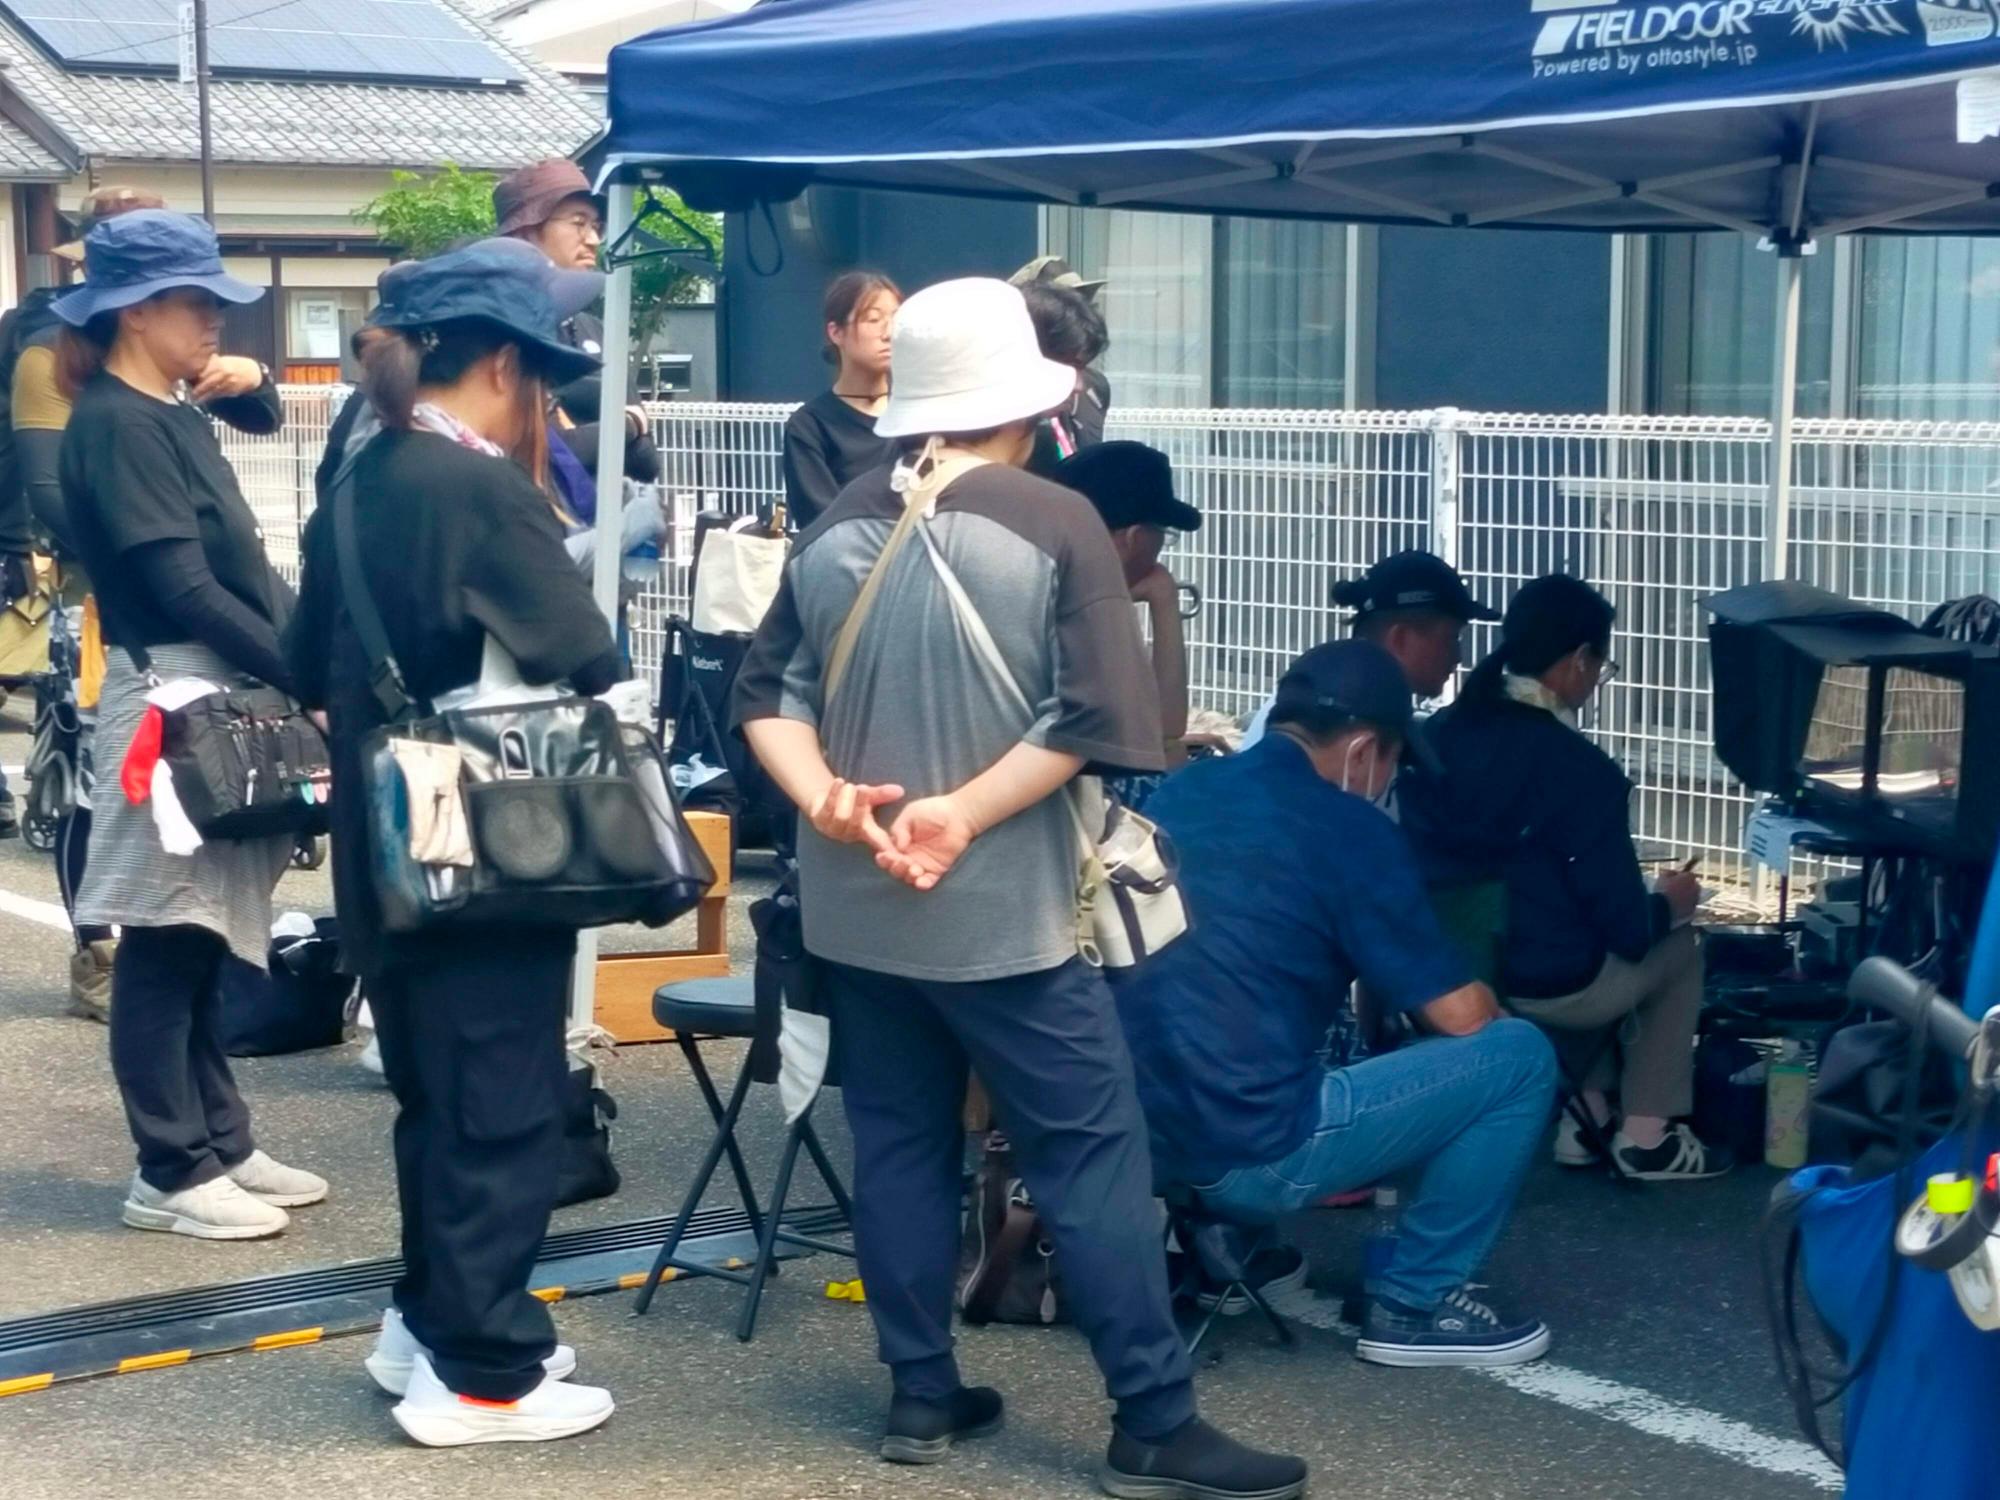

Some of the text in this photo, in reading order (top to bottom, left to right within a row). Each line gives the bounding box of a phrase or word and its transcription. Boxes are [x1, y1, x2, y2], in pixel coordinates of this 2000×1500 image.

[1576, 1, 1752, 50] FIELDOOR
[1532, 40, 1758, 79] Powered by ottostyle.jp
